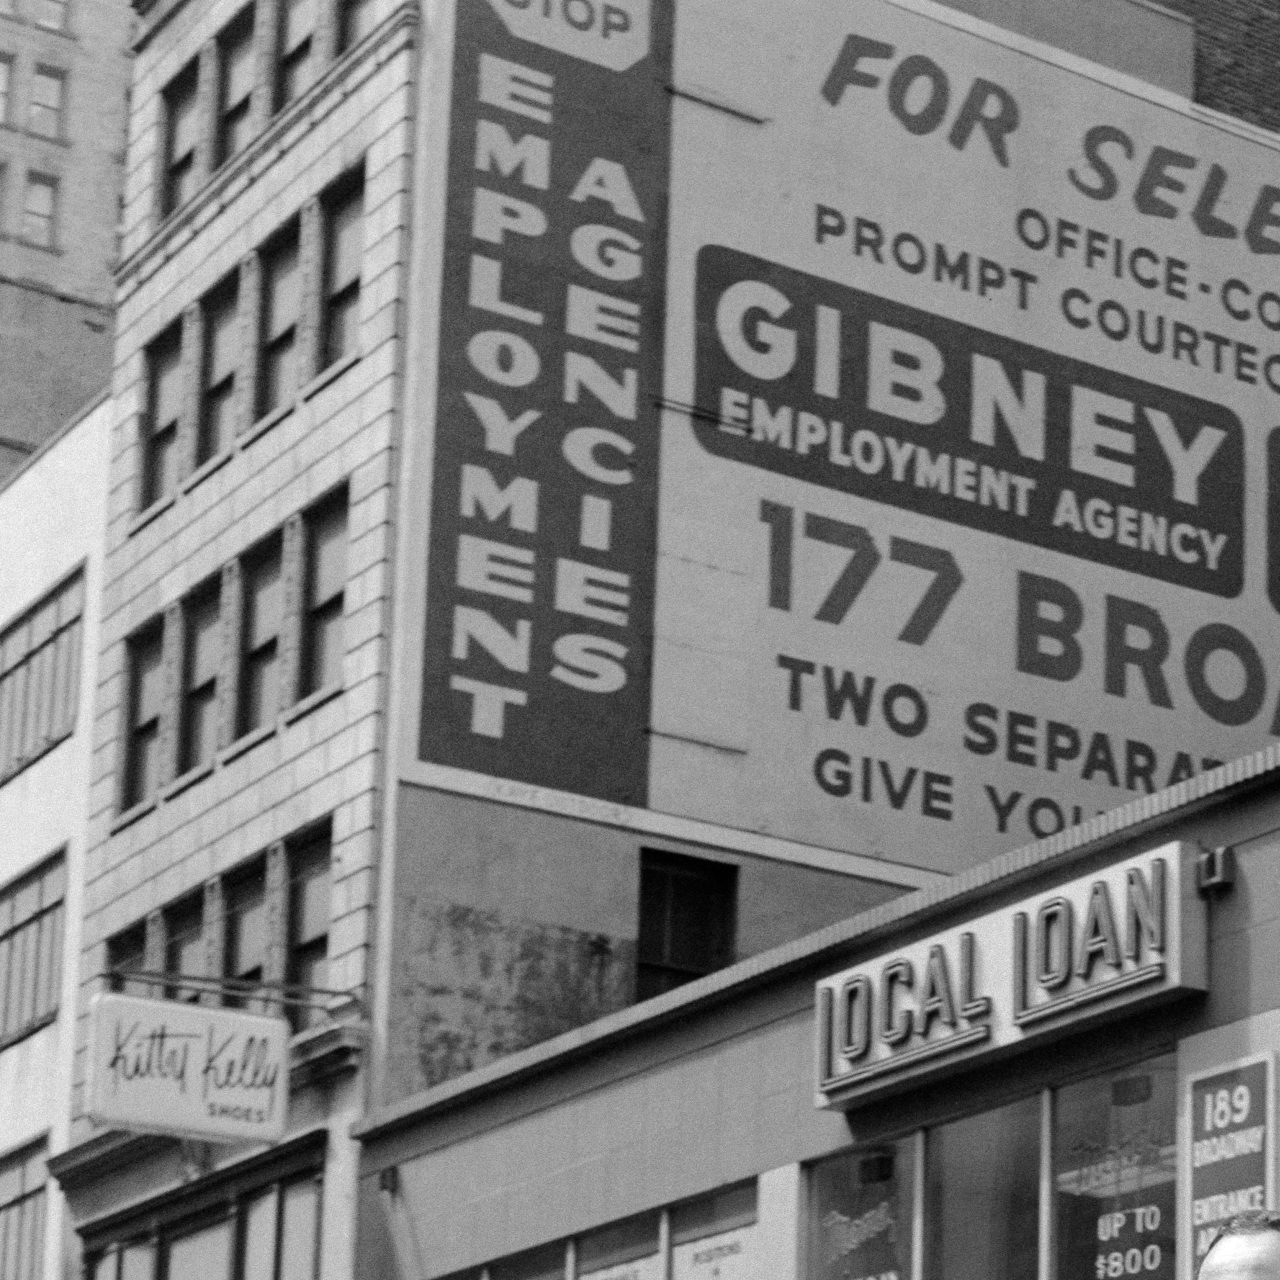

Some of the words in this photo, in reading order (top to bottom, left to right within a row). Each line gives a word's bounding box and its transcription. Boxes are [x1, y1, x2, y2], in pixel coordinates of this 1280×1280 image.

[821, 33, 1019, 168] FOR
[814, 203, 1037, 311] PROMPT
[450, 52, 554, 739] EMPLOYMENT
[549, 156, 647, 693] AGENCIES
[715, 279, 1228, 506] GIBNEY
[718, 386, 1036, 517] EMPLOYMENT
[1053, 489, 1228, 571] AGENCY
[759, 499, 965, 647] 177
[777, 653, 929, 737] TWO
[813, 748, 954, 821] GIVE
[985, 785, 1105, 839] YO
[819, 932, 992, 1093] LOCAL
[1012, 857, 1166, 1027] LOAN
[109, 1020, 201, 1094] Kitty
[202, 1025, 279, 1121] Kelly
[208, 1101, 266, 1123] SHOES
[1203, 1085, 1250, 1132] 189
[1095, 1245, 1161, 1280] $800
[1097, 1213, 1126, 1241] UP
[1134, 1205, 1160, 1233] TO
